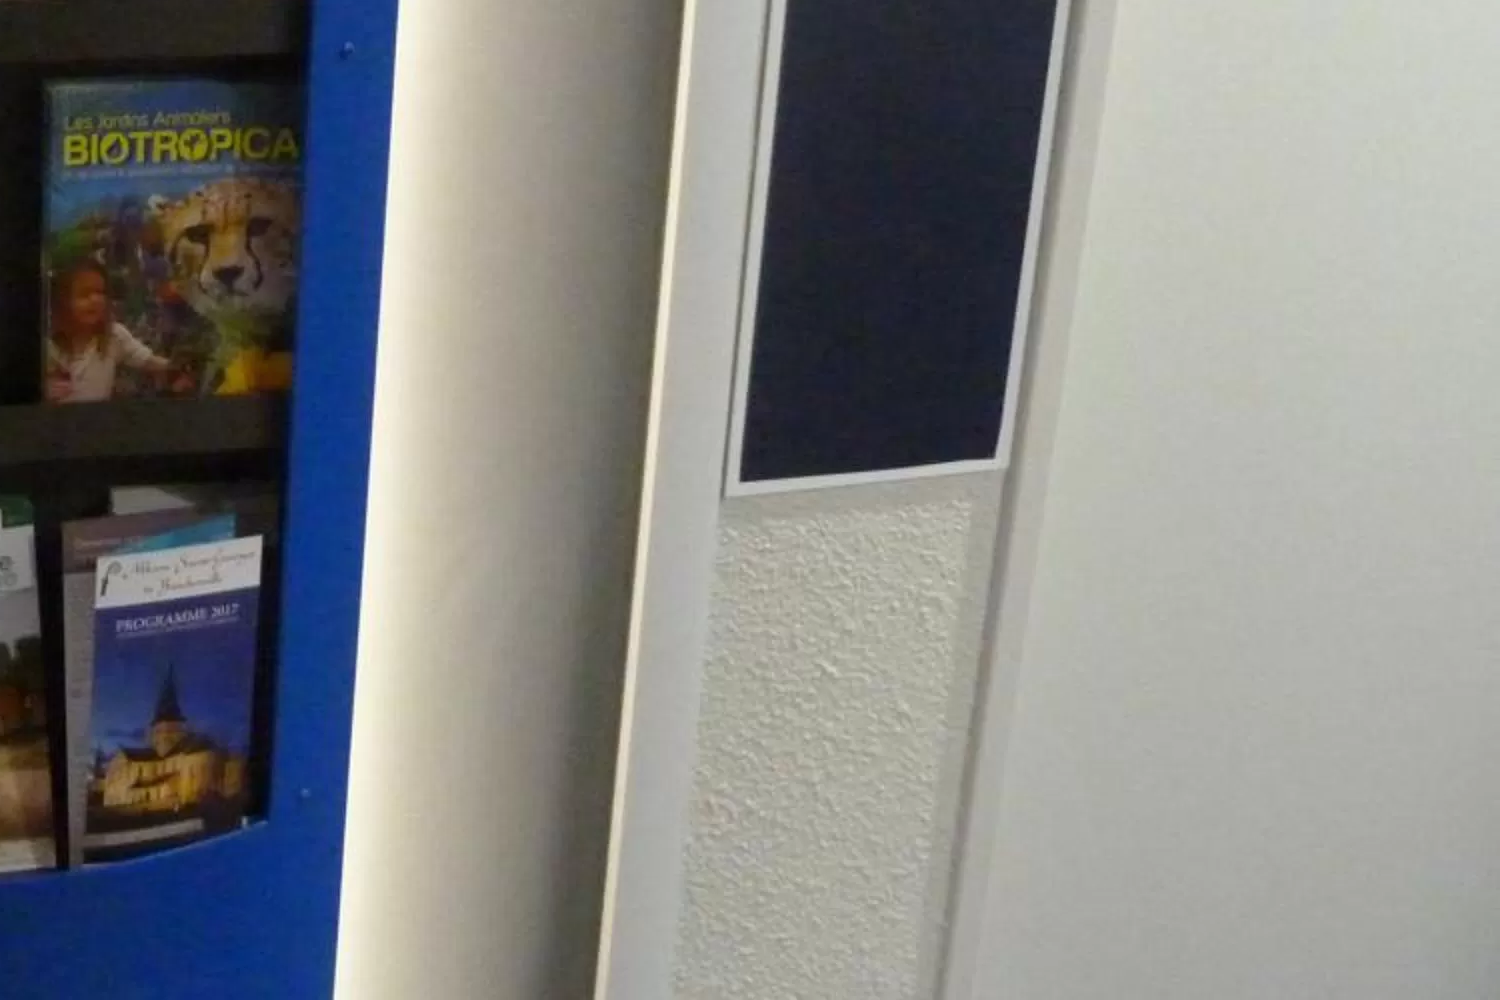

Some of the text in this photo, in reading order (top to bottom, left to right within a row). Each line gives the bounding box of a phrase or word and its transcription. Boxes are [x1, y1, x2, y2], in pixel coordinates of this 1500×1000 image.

[63, 126, 298, 166] BIOTROPICA
[115, 605, 207, 634] PROGRAMME
[210, 602, 240, 618] 2017
